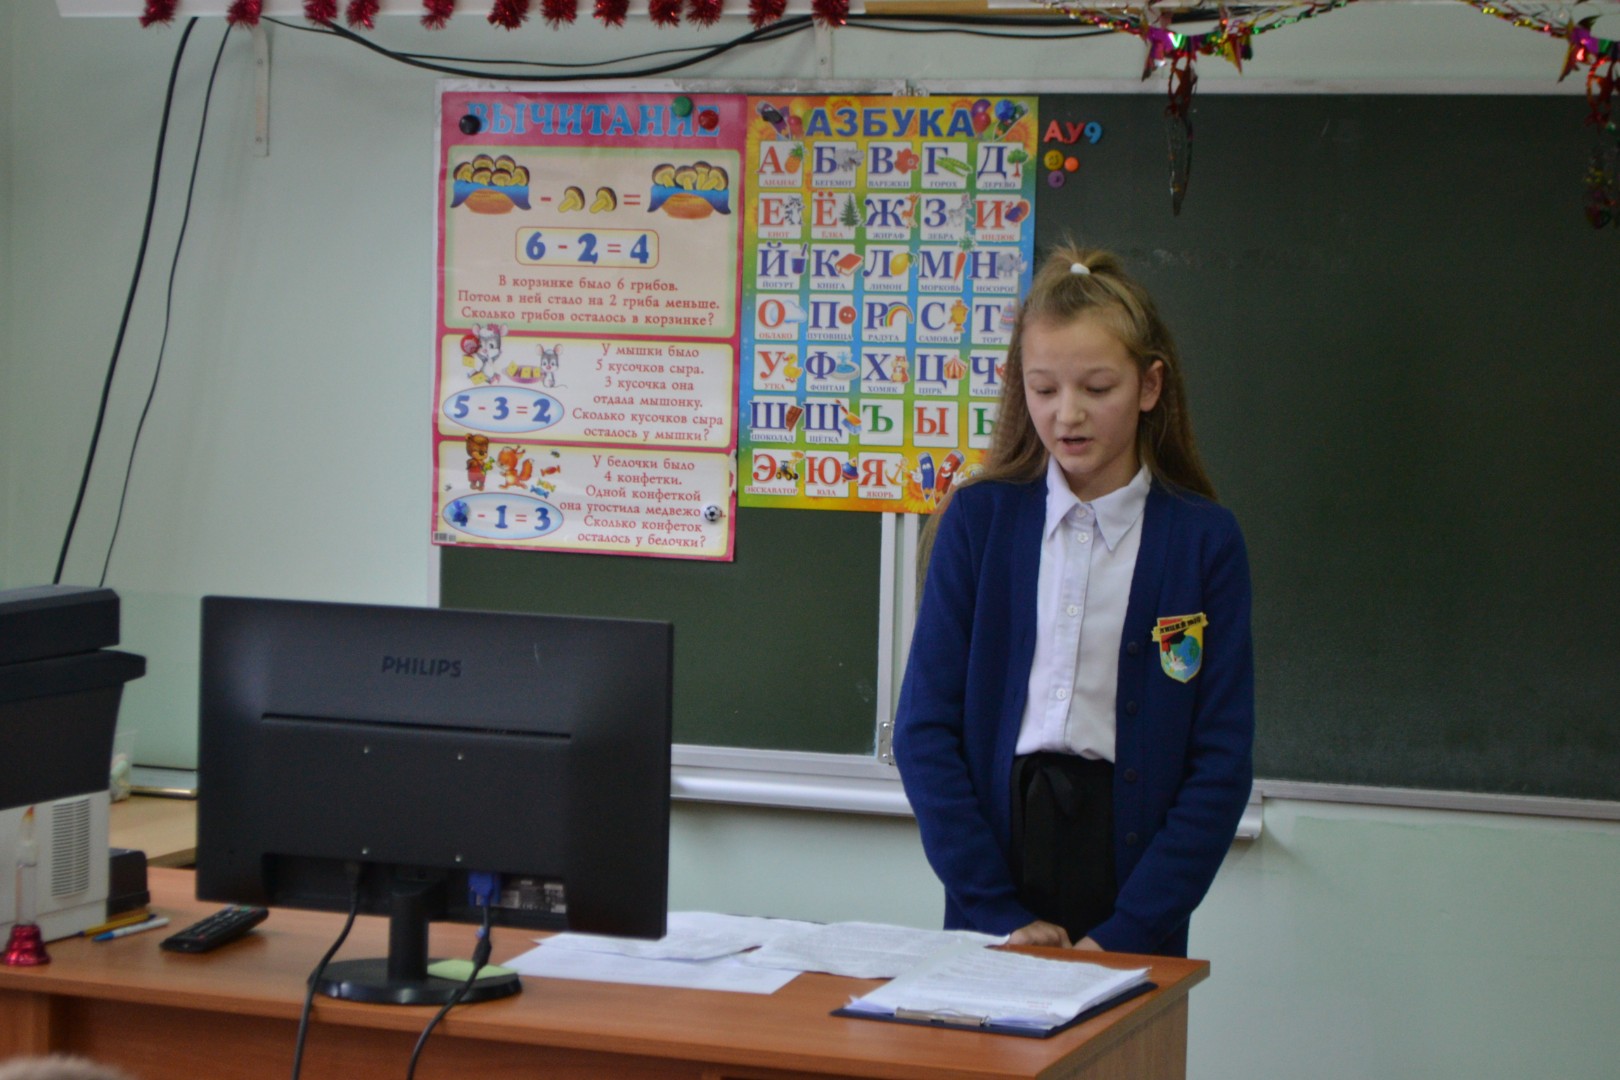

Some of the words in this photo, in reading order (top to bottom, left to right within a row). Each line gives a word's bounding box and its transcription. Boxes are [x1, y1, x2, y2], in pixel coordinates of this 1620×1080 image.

[805, 108, 975, 138] АЗБУКА
[813, 191, 837, 226] Ё
[525, 231, 546, 260] 6
[577, 233, 598, 264] 2
[630, 234, 649, 264] 4
[498, 274, 507, 286] В
[512, 278, 574, 290] корзинке
[579, 276, 611, 289] было
[617, 278, 624, 290] 6
[630, 279, 678, 294] грибов.
[762, 281, 793, 289] ЙОГУРТ
[458, 290, 500, 302] Потом
[520, 293, 542, 304] ней
[548, 296, 582, 305] стало
[588, 297, 603, 306] на
[609, 294, 617, 306] 2
[623, 296, 660, 310] гриба
[665, 300, 720, 310] меньше.
[461, 306, 515, 319] Сколько
[521, 309, 565, 323] грибов
[570, 314, 626, 323] осталось
[644, 312, 714, 328] корзинке?
[616, 346, 662, 356] мышки
[668, 345, 699, 358] было
[596, 359, 603, 370] 5
[608, 362, 664, 374] кусочков
[669, 365, 704, 377] сыра.
[605, 376, 612, 387] 3
[618, 379, 666, 391] кусочка
[672, 382, 694, 391] она
[453, 395, 470, 419] 5
[493, 397, 509, 420] 3
[532, 399, 551, 424] 2
[593, 395, 634, 406] отдала
[640, 397, 703, 411] мышонку.
[572, 408, 625, 421] Сколько
[631, 413, 687, 425] кусочков
[693, 416, 723, 428] сыра
[584, 427, 637, 439] осталось
[655, 428, 709, 441] мышки?
[751, 434, 794, 442] ШОКОЛАД
[607, 456, 658, 469] белочки
[663, 458, 695, 471] было
[604, 471, 612, 482] 4
[617, 472, 682, 487] конфетки.
[586, 485, 626, 498] Одной
[632, 489, 701, 503] конфеткой
[746, 487, 797, 495] ЭКСКАВАТОР
[560, 502, 581, 511] она
[587, 503, 640, 514] угостила
[495, 505, 508, 529] 1
[534, 507, 551, 531] 3
[584, 515, 636, 529] Сколько
[642, 519, 702, 534] конфеток
[578, 533, 630, 543] осталось
[648, 535, 706, 548] белочки?
[382, 655, 462, 678] PHILIPS
